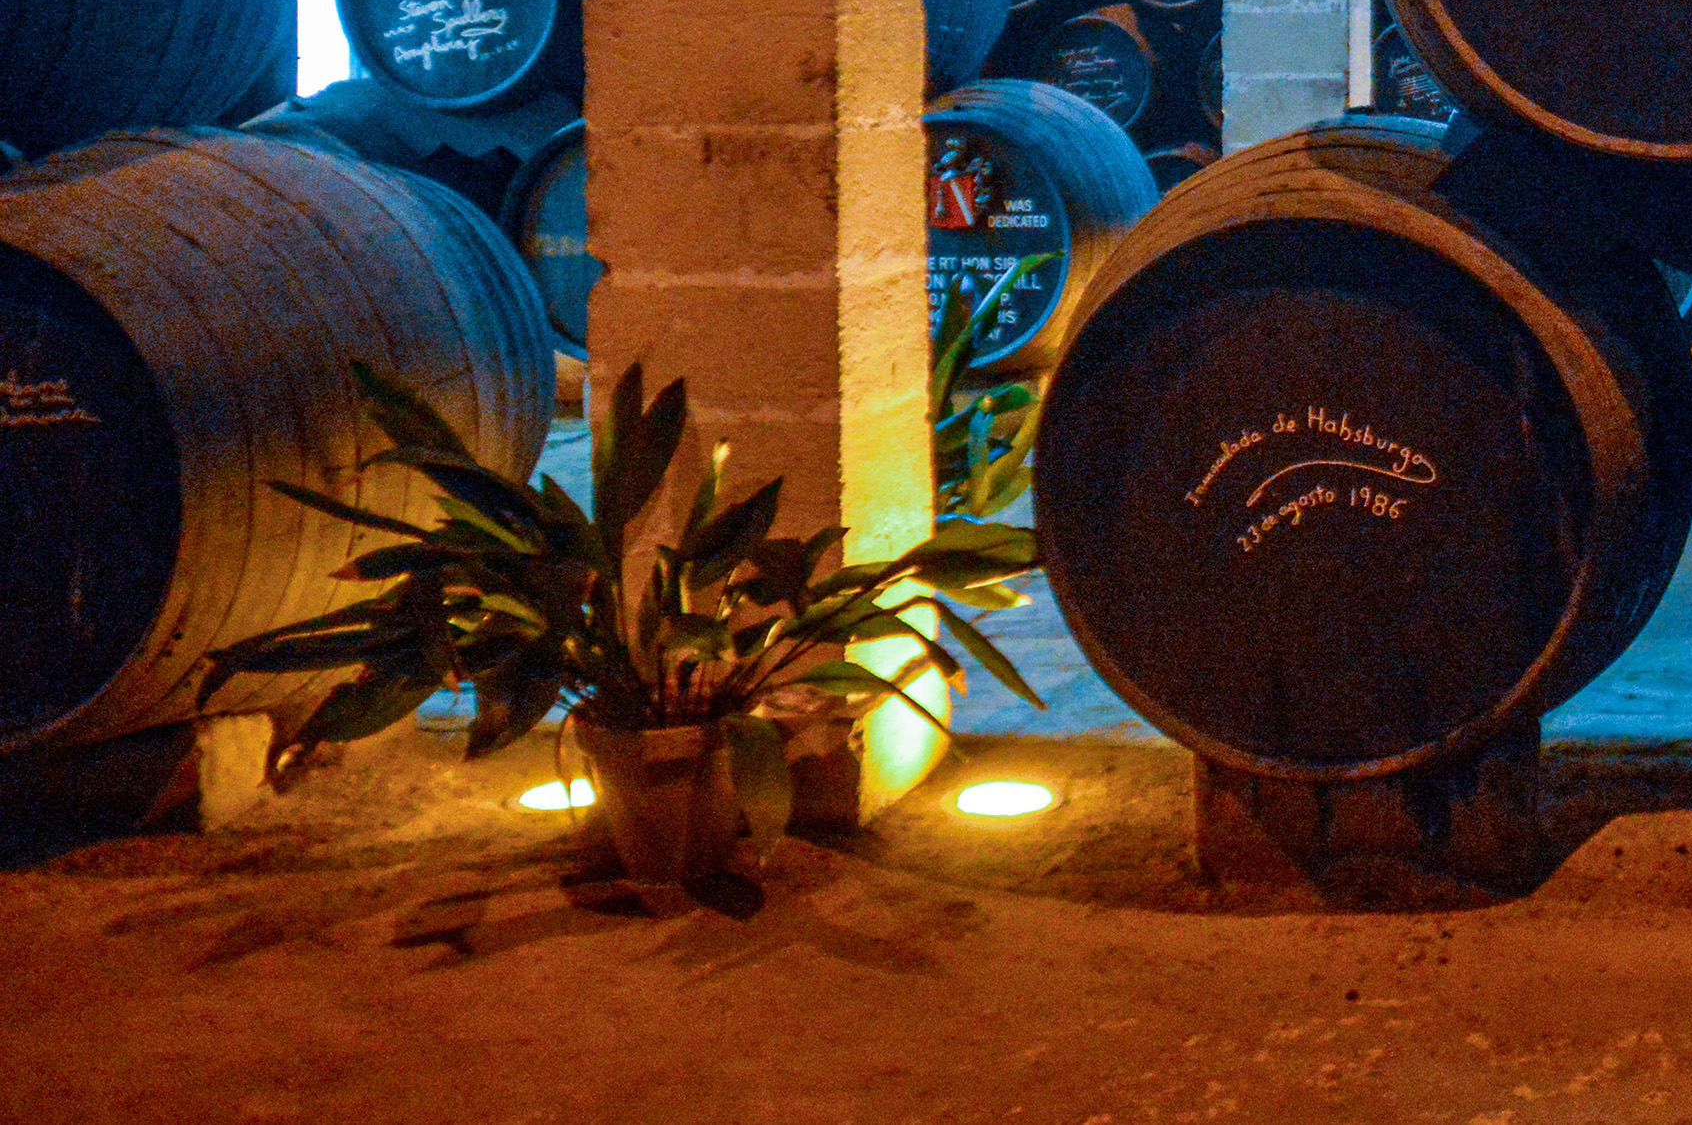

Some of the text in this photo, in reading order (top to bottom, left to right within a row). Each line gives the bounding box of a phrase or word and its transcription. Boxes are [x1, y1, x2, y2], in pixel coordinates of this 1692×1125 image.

[1004, 199, 1032, 212] WAS
[988, 215, 1048, 228] DEDICATED
[1273, 413, 1296, 433] de
[1308, 405, 1424, 473] Habsburgo
[1351, 486, 1408, 520] 1986
